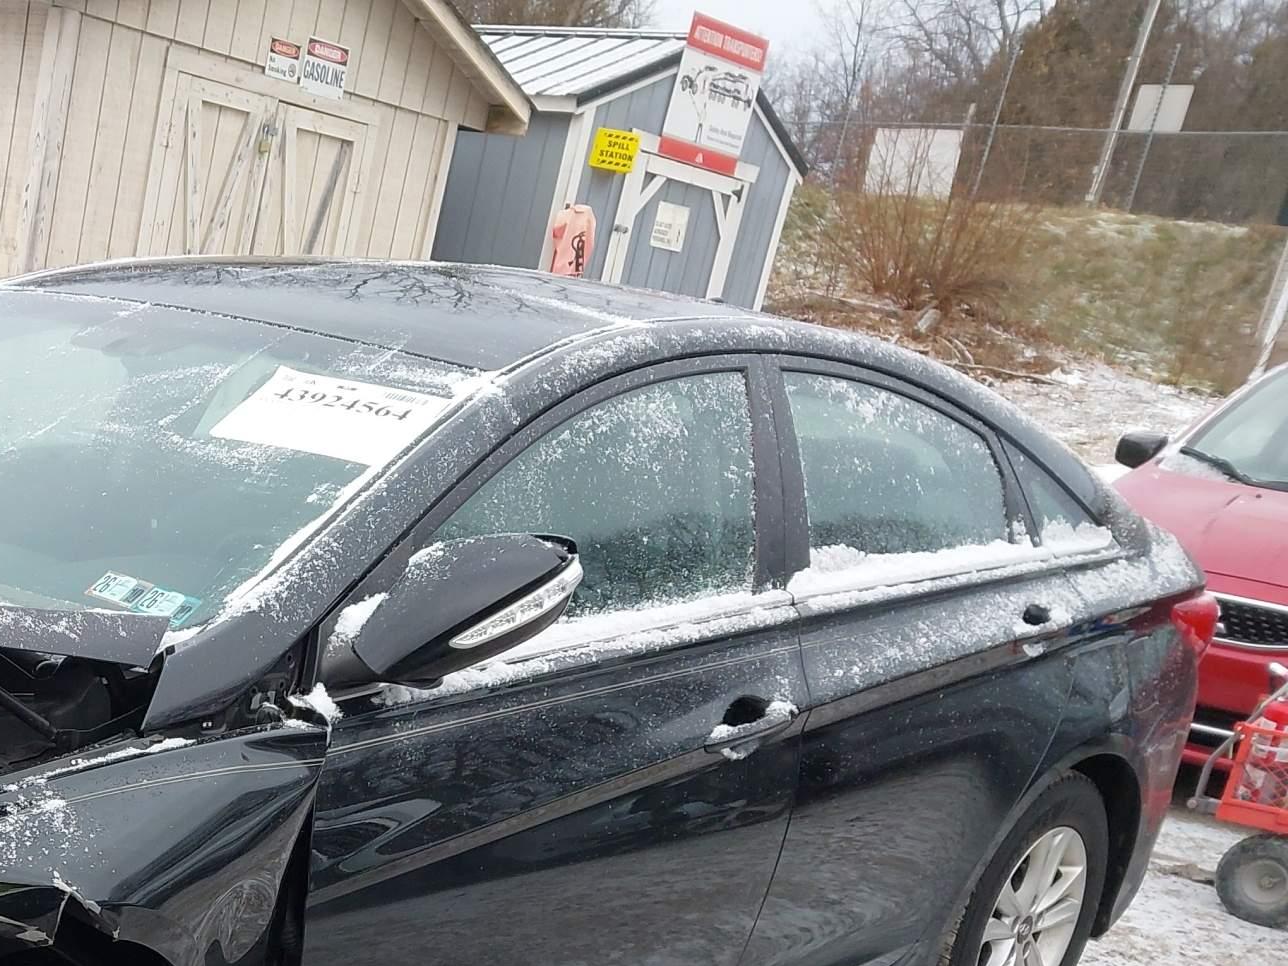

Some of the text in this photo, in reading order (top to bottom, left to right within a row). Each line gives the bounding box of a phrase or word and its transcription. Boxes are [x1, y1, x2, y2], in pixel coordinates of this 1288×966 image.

[304, 60, 345, 89] GASOLINE
[607, 140, 630, 151] SPILL
[599, 149, 633, 162] STATION
[274, 387, 412, 421] 43924564
[92, 575, 117, 593] 26
[140, 590, 165, 609] 26
